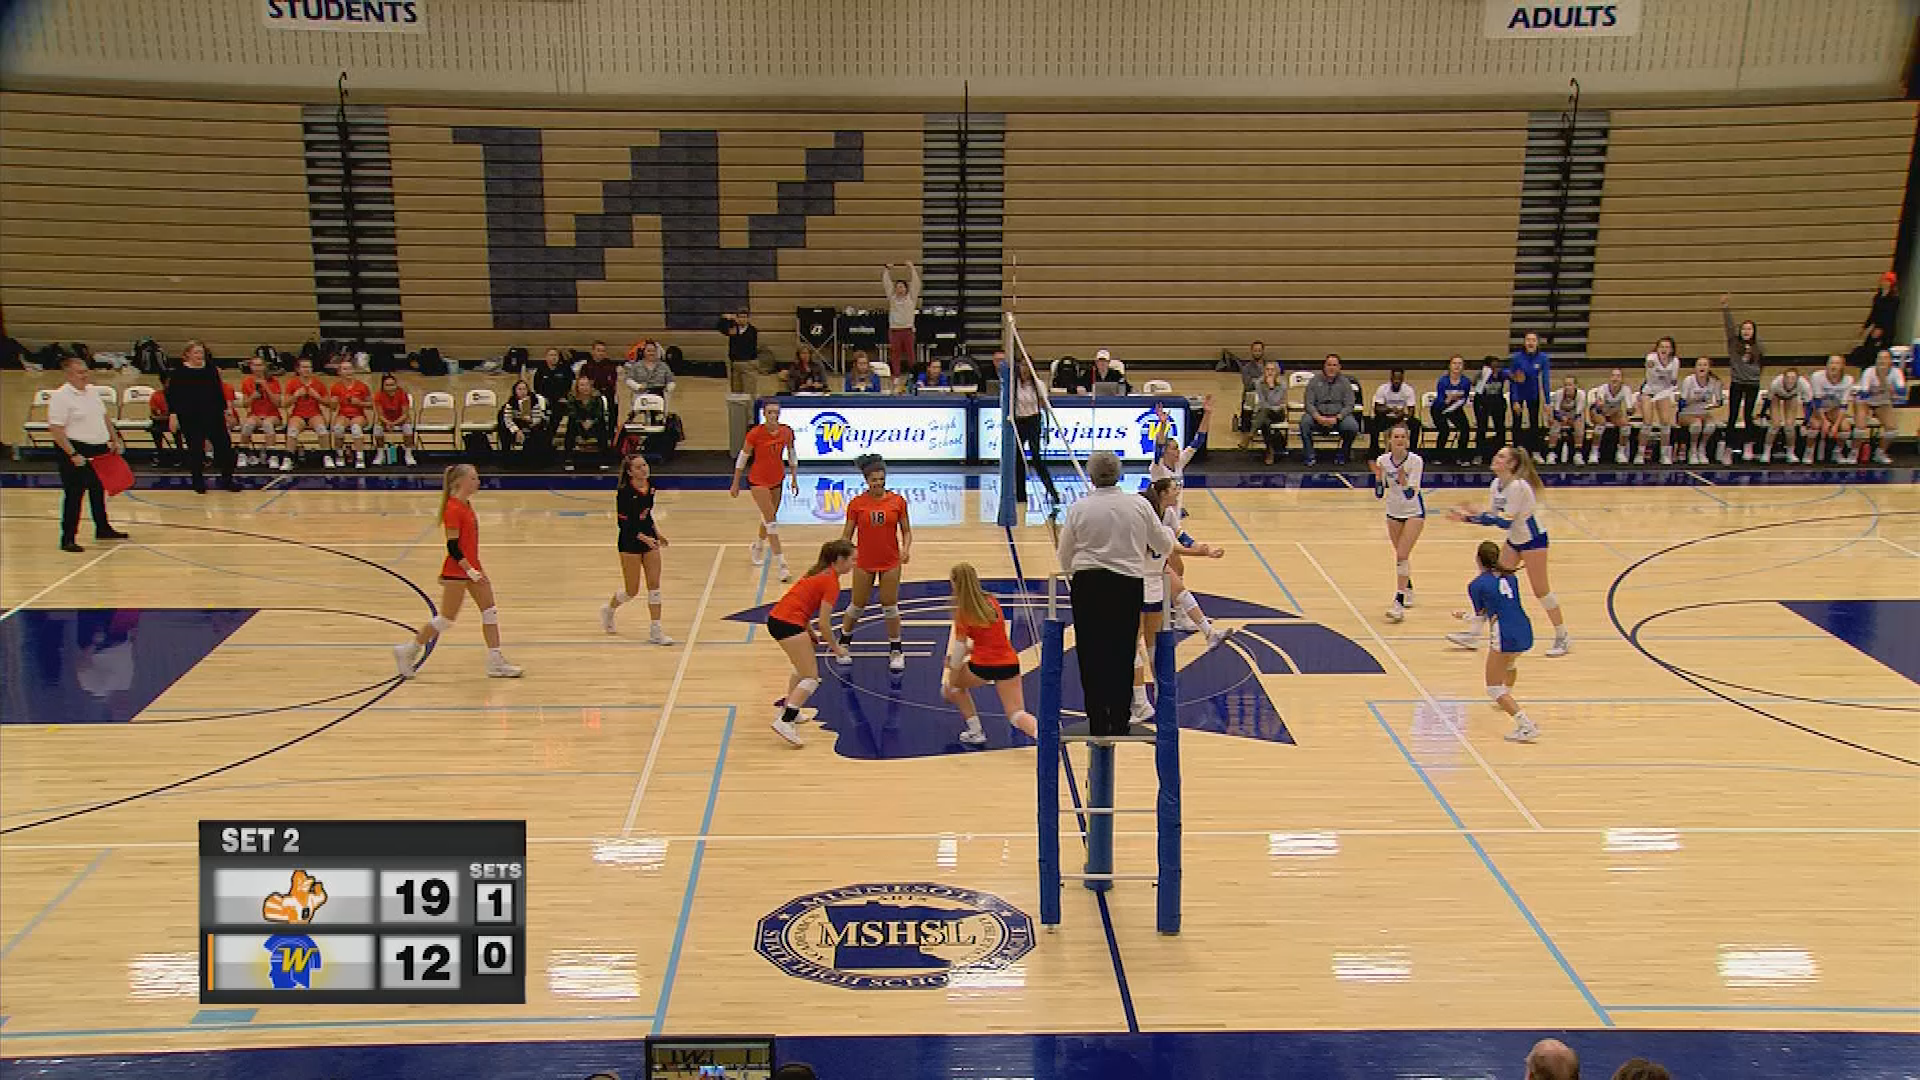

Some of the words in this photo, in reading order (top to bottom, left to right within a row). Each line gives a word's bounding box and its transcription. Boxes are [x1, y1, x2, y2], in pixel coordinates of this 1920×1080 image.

[268, 0, 418, 23] STUDENTS
[1507, 5, 1617, 29] ADULTS
[452, 127, 865, 330] W
[823, 419, 926, 449] Wayzata
[1040, 421, 1129, 444] rojans
[870, 511, 885, 525] 18
[1499, 577, 1514, 599] 4
[816, 920, 976, 948] MSHSL
